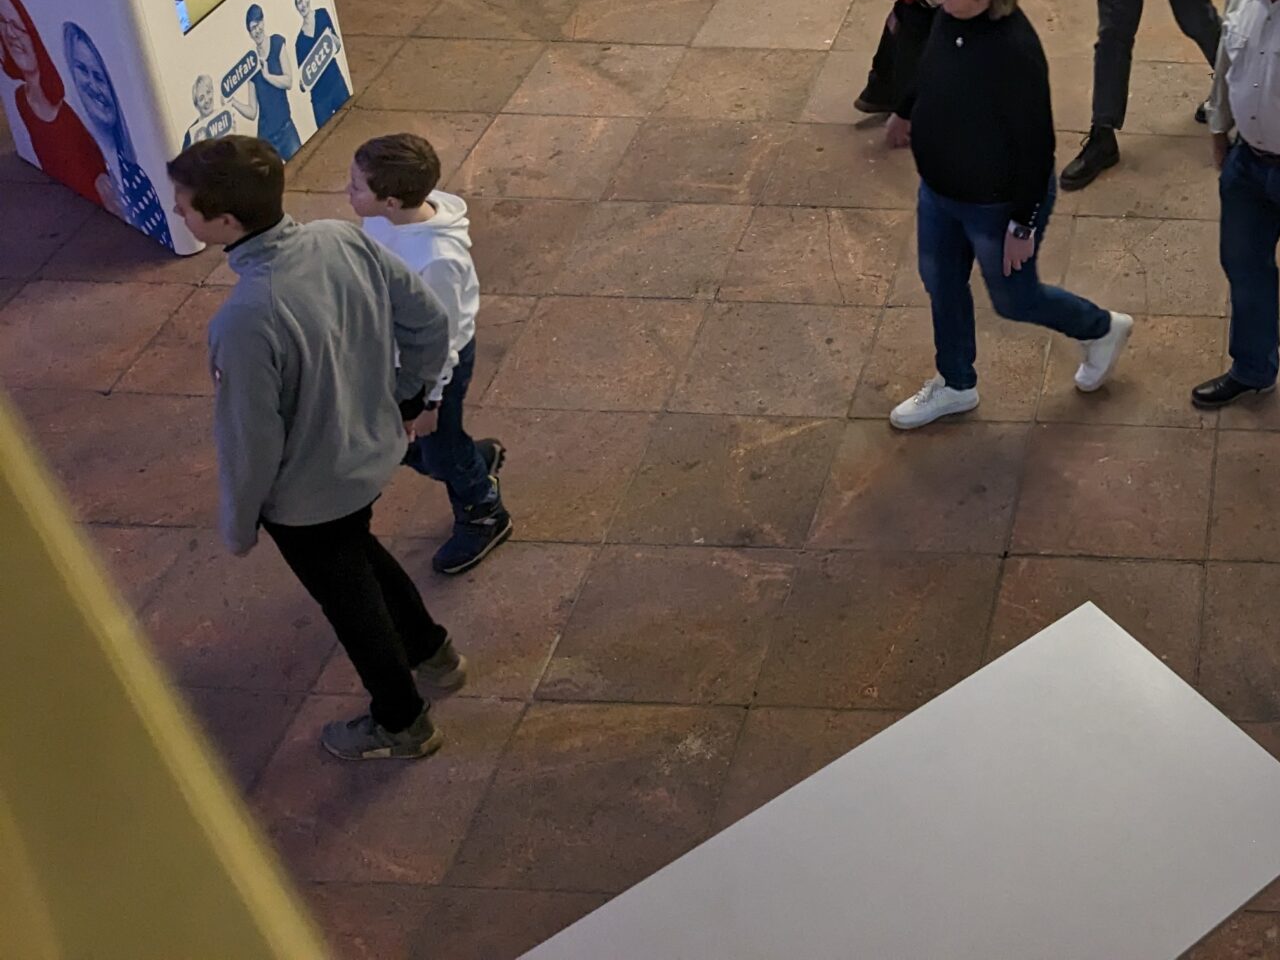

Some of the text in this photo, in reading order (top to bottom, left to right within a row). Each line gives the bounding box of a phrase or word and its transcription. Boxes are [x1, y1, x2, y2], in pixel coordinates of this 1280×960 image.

[223, 54, 256, 92] Vielfalt
[305, 41, 331, 80] Fetzt
[208, 114, 229, 137] Weil
